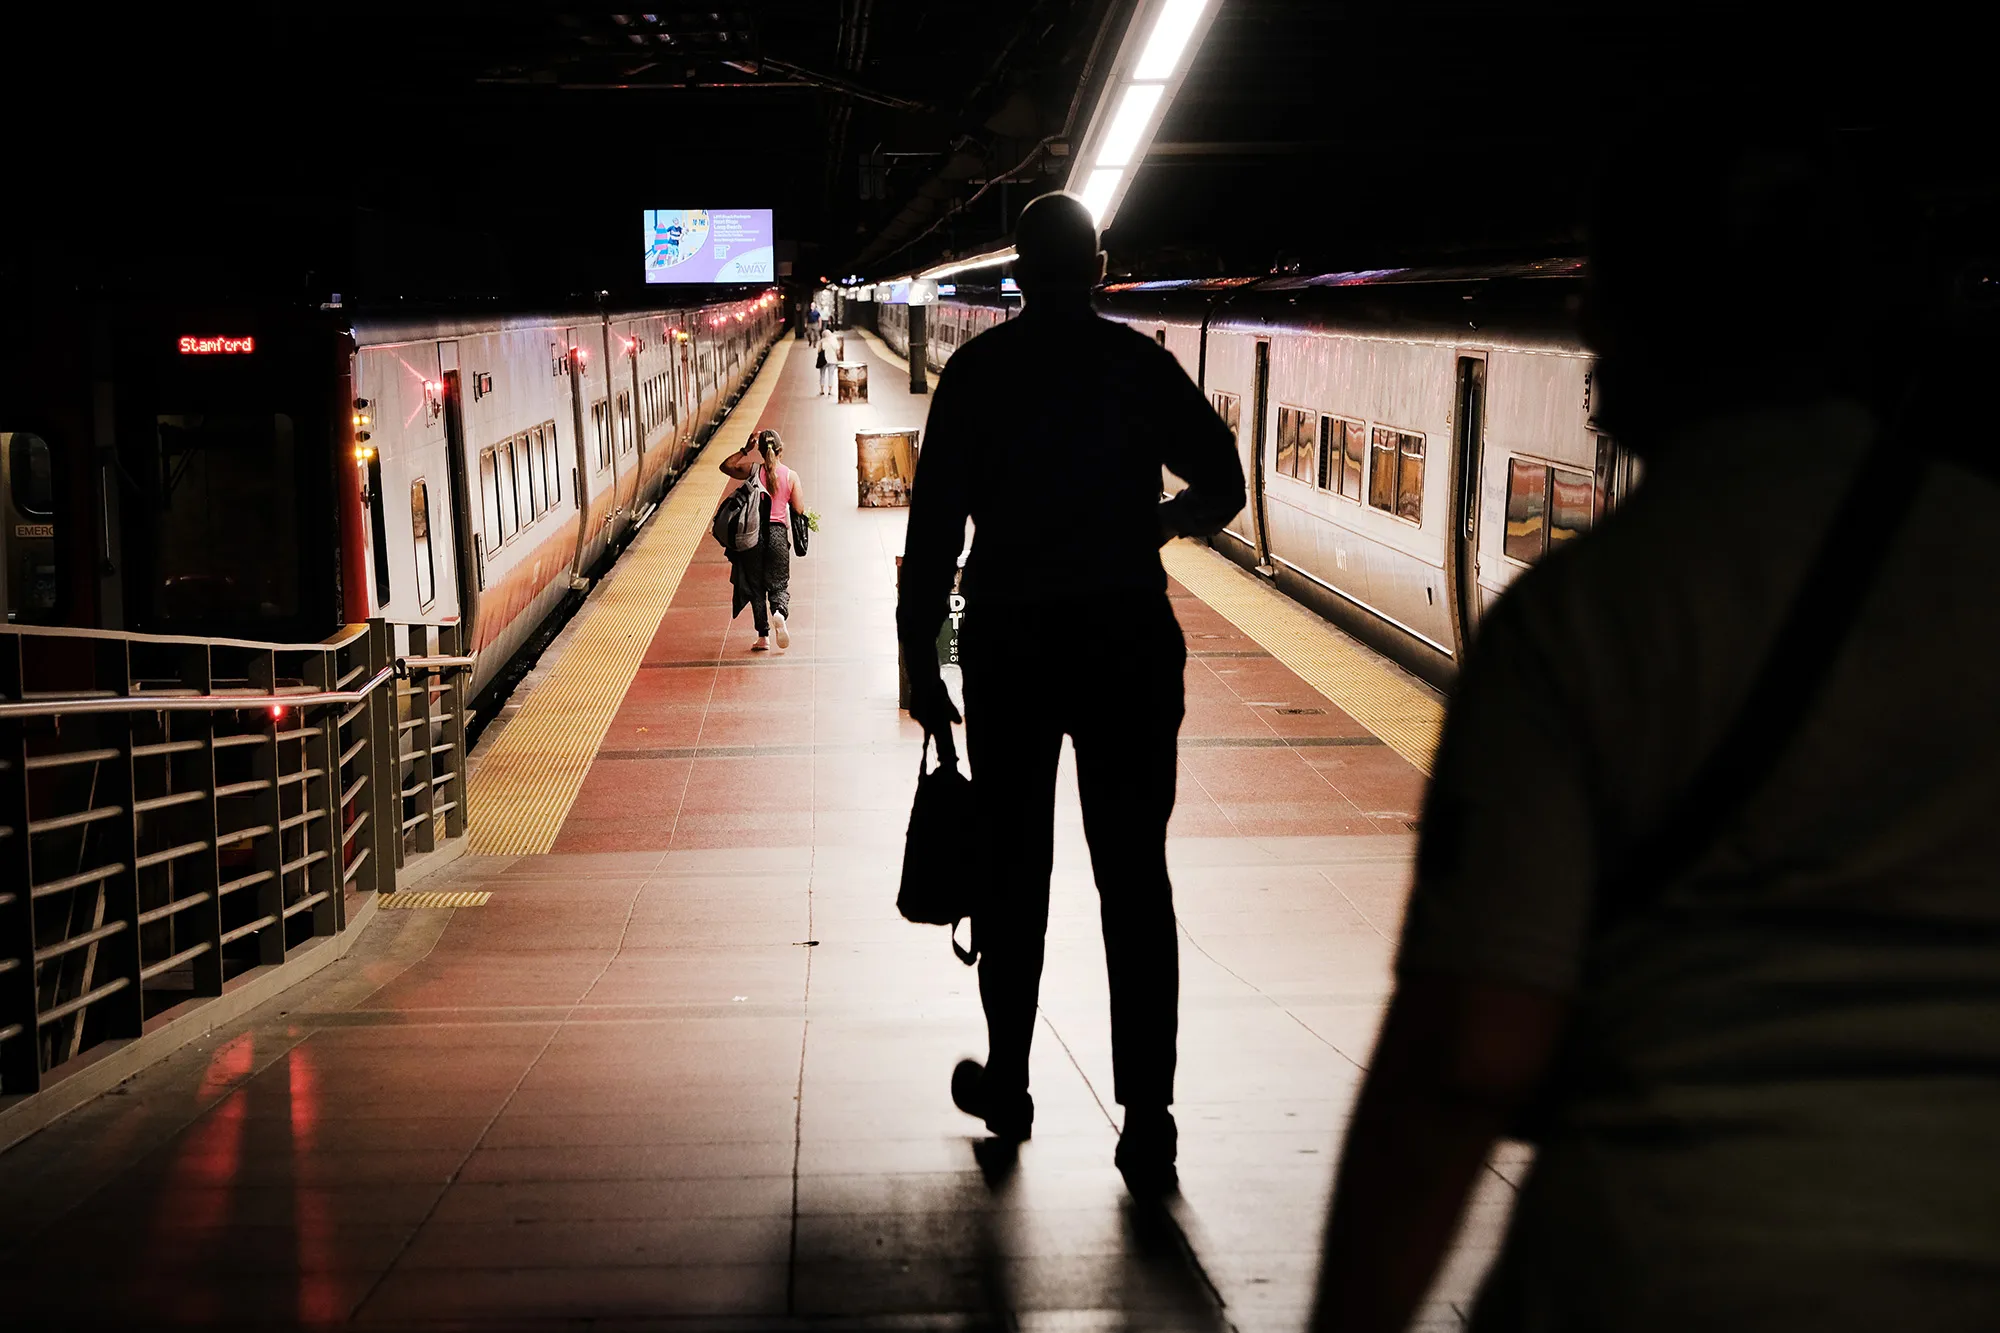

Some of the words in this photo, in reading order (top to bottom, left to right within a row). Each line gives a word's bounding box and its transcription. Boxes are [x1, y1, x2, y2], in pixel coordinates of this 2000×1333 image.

[737, 264, 767, 274] AWAY
[179, 335, 254, 354] Stamford
[950, 594, 966, 612] D
